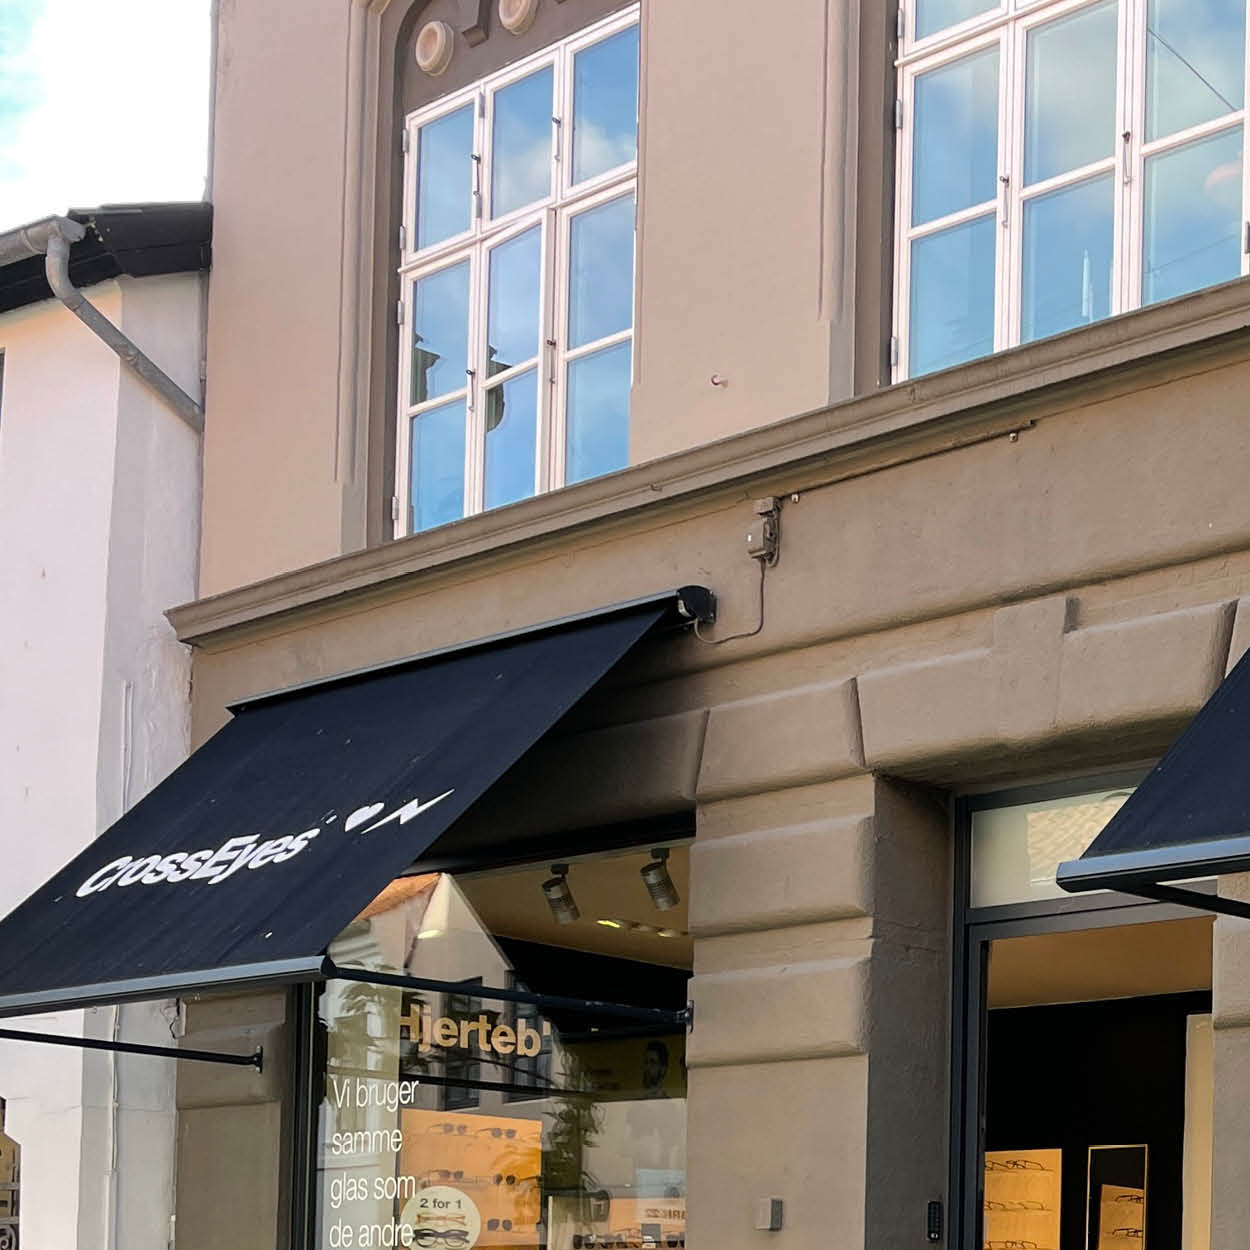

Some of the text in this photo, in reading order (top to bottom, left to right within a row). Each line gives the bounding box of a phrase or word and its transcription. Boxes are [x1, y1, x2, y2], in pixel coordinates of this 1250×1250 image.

[331, 1078, 420, 1113] Vi bruger
[331, 1128, 403, 1154] samme
[330, 1172, 417, 1209] glas som
[419, 1198, 463, 1210] 2 for 1
[328, 1216, 414, 1249] de andre
